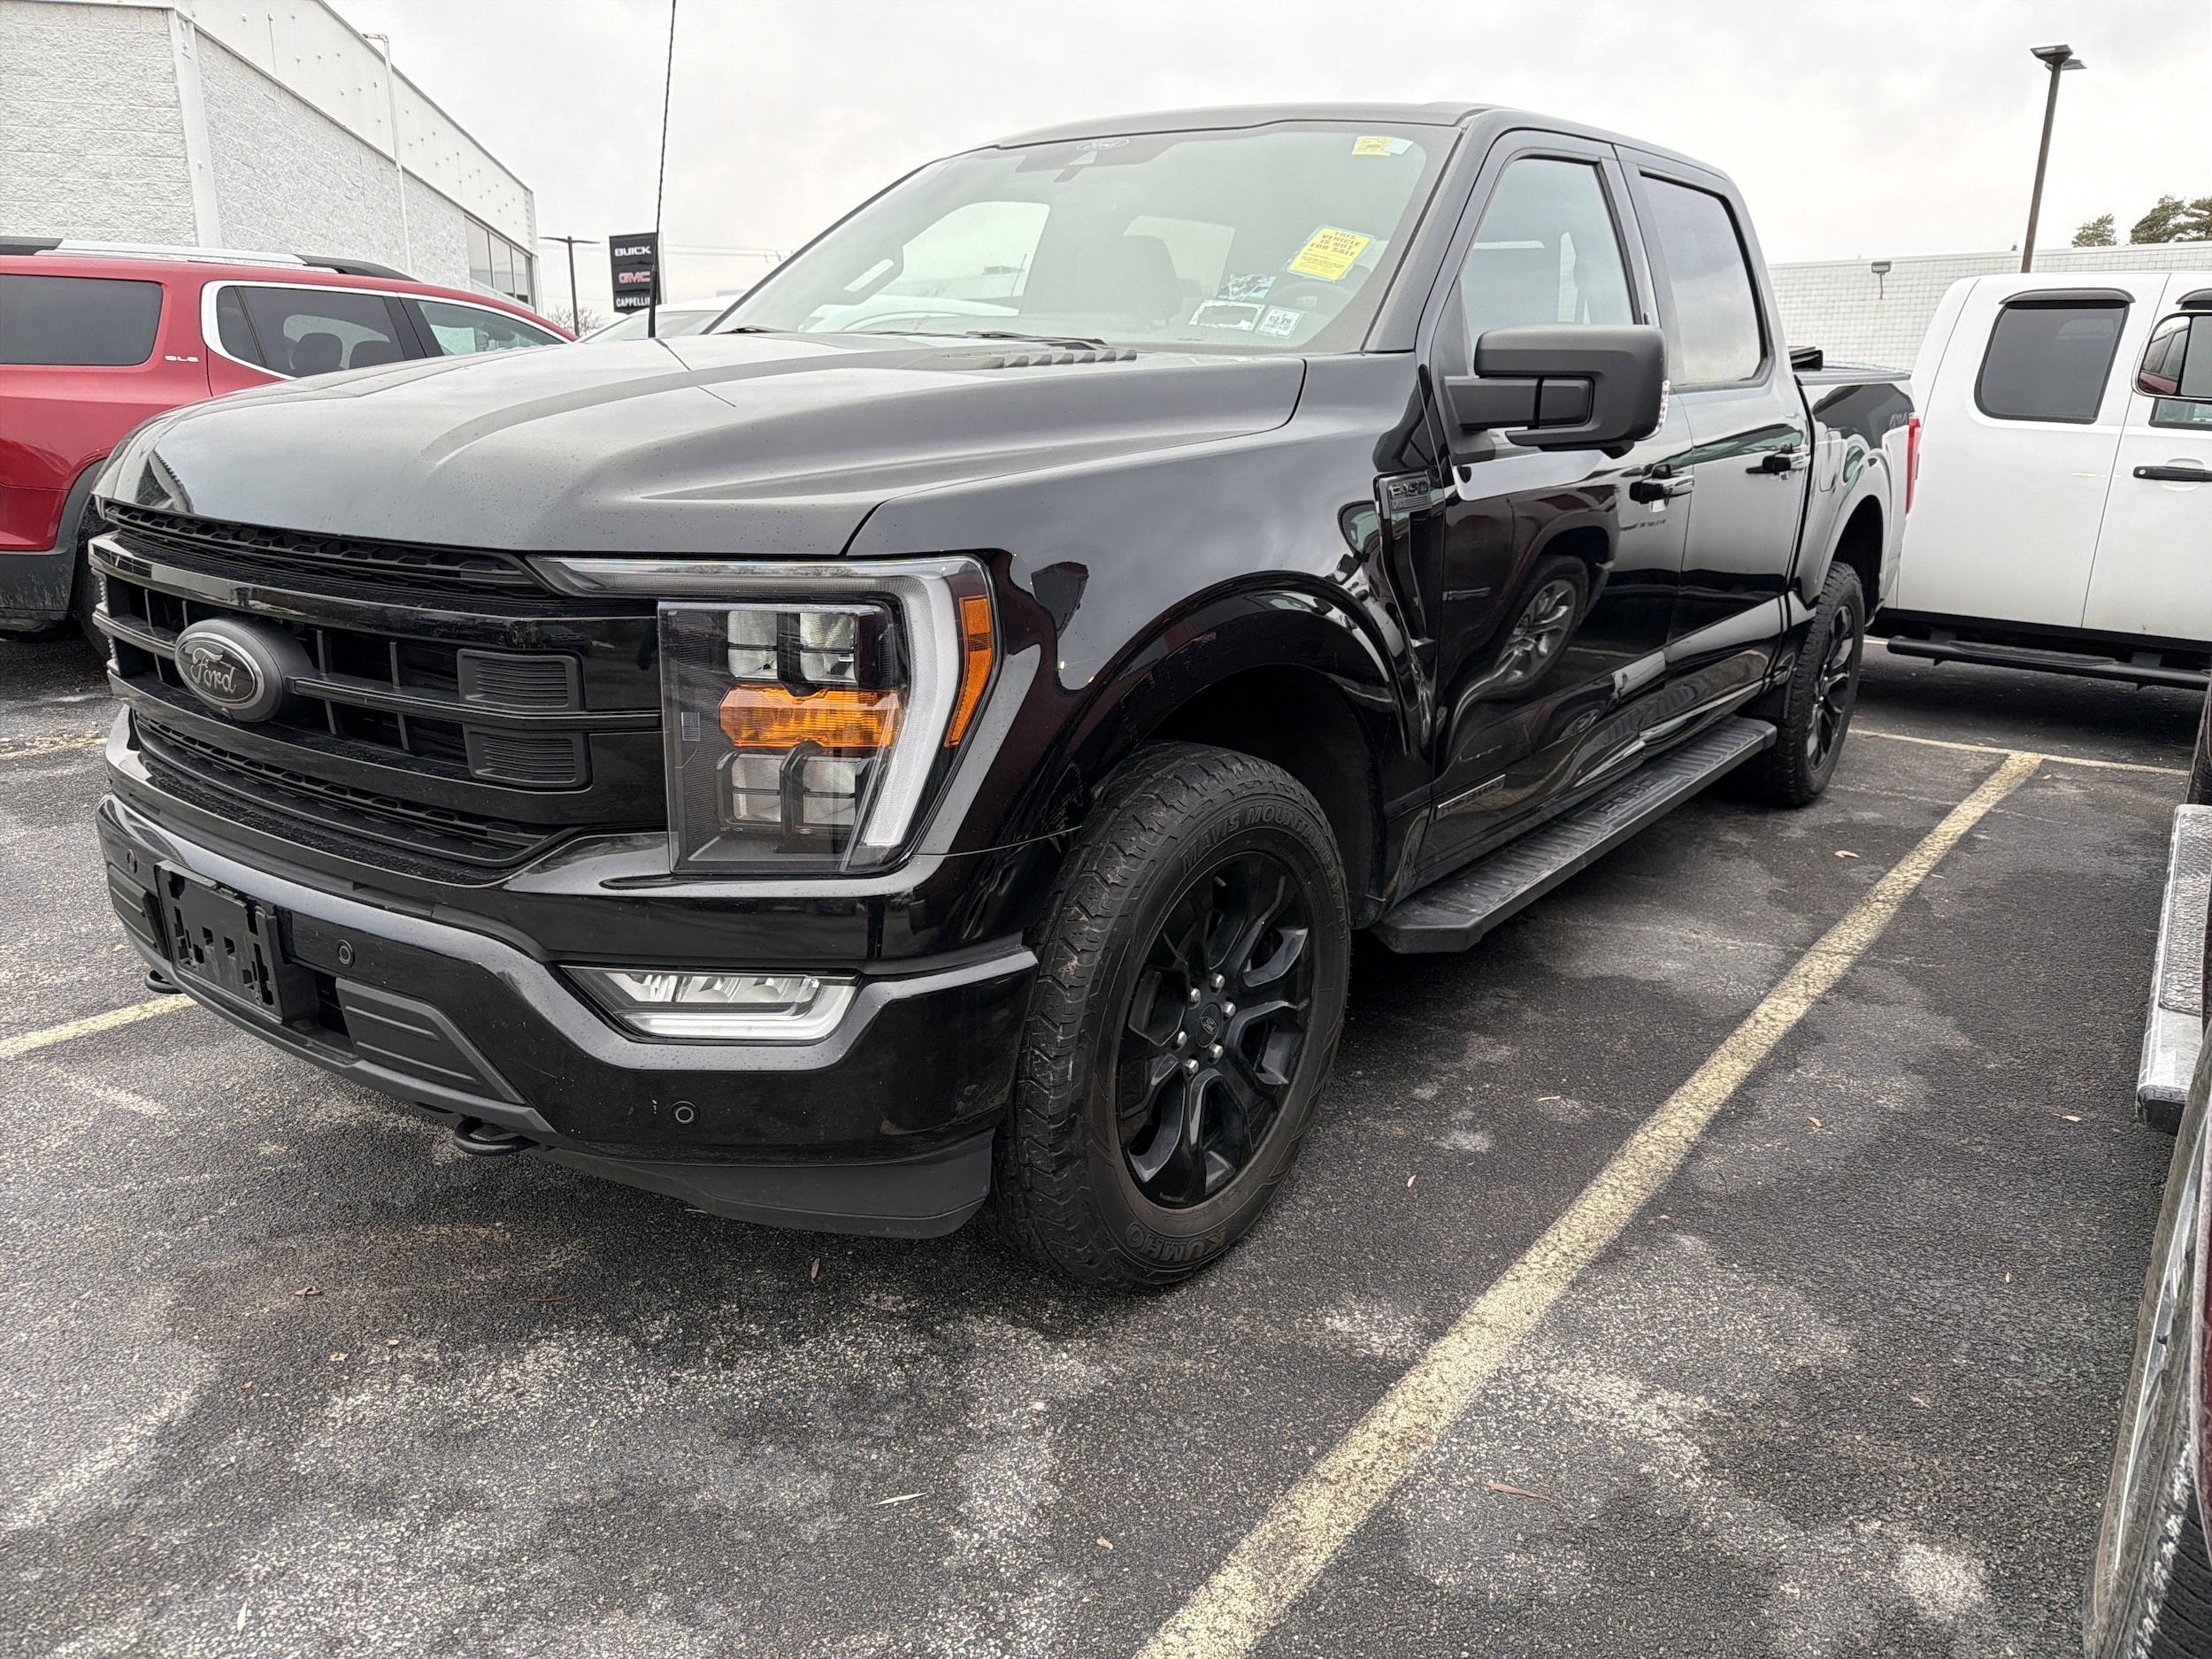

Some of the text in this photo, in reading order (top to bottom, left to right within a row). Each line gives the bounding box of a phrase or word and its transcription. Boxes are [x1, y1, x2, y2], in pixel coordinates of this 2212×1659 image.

[1322, 234, 1362, 247] VEHICLE
[1334, 231, 1357, 240] THIS
[614, 246, 651, 257] BUICK
[1331, 247, 1357, 257] SALE
[1333, 242, 1356, 250] NOT
[618, 271, 651, 284] GMC
[189, 647, 237, 695] Ford
[1181, 809, 1240, 875] MAVIS
